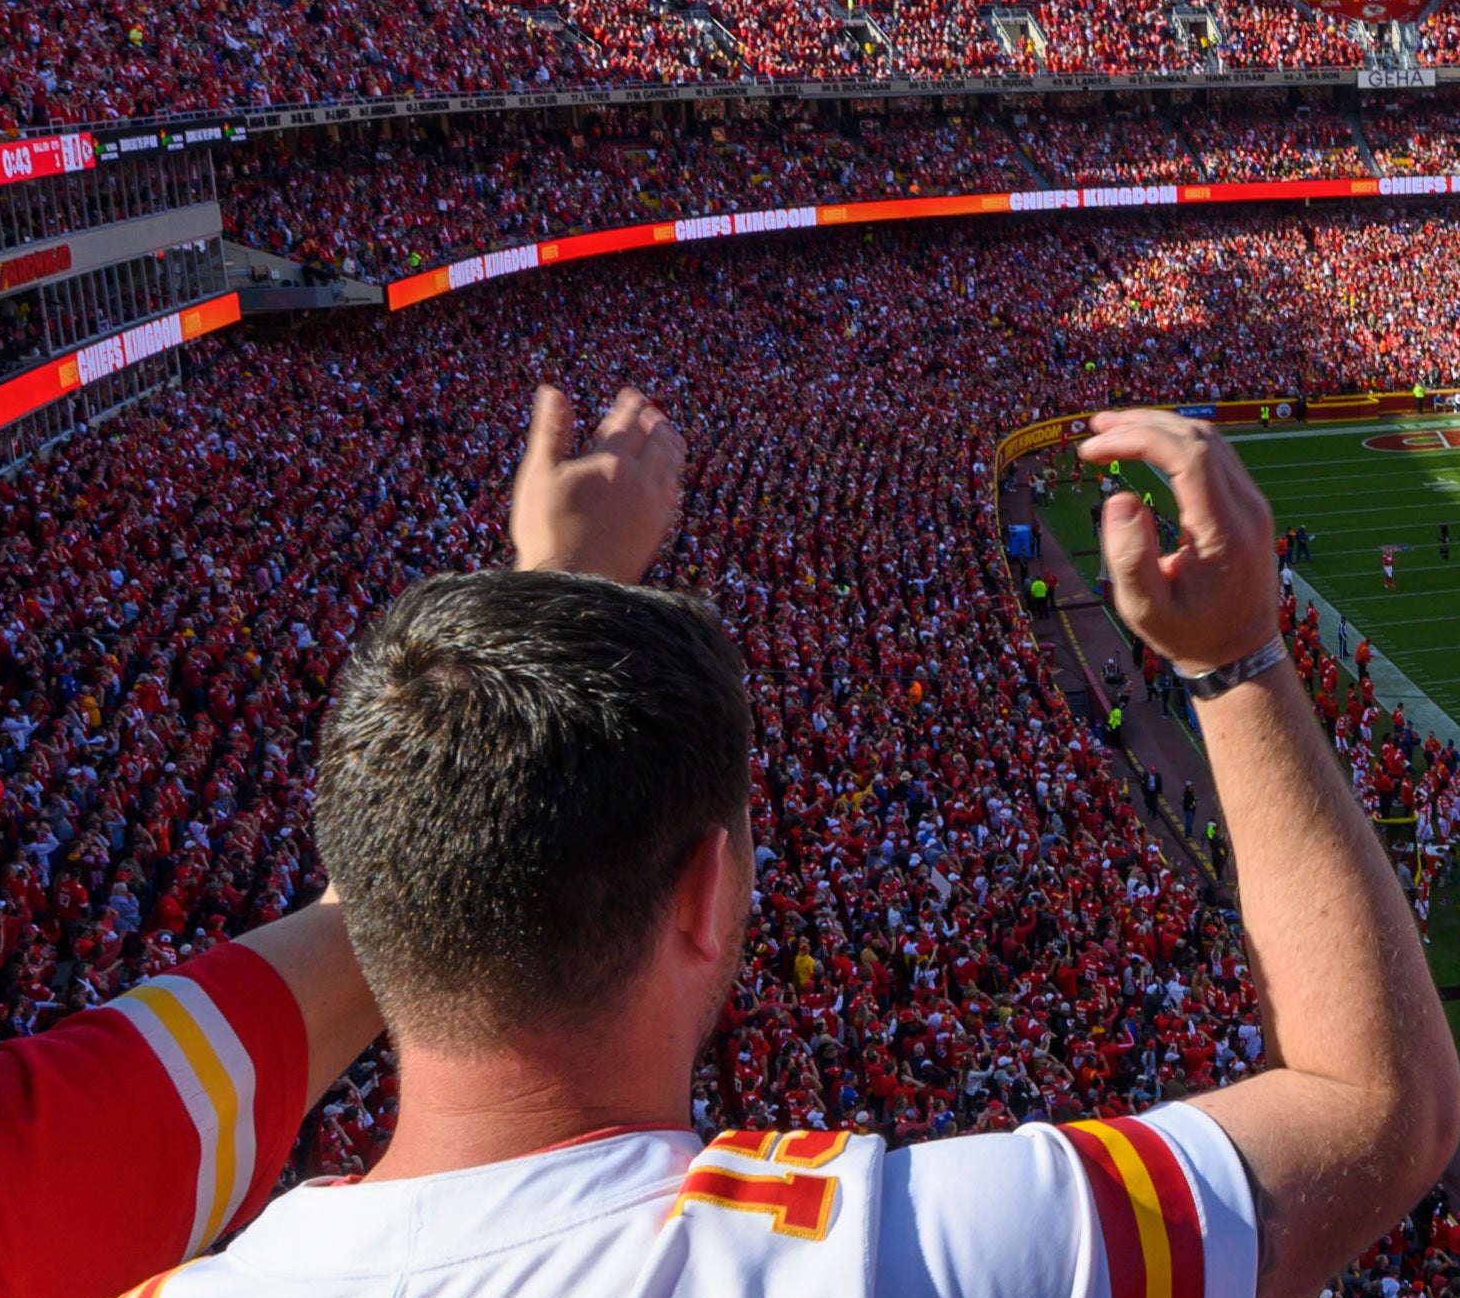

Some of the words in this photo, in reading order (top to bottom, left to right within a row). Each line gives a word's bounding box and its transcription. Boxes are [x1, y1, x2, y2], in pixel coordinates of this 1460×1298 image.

[1148, 74, 1188, 84] THOMAS
[1206, 73, 1232, 83] HANK
[1233, 73, 1265, 82] STRAM
[1368, 71, 1425, 88] GEHA
[1, 146, 32, 178] 0:43
[1010, 189, 1079, 211] CHIEFS
[1083, 184, 1177, 208] KINGDOM
[1378, 175, 1447, 195] CHIEFS
[675, 215, 732, 241] CHIEFS
[734, 206, 818, 234] KINGDOM
[448, 257, 483, 290] CHIEFS
[484, 243, 540, 278] KINGDOM
[76, 334, 125, 386] CHIEFS
[122, 312, 183, 366] KINGDOM
[1018, 423, 1063, 450] KINGDOM
